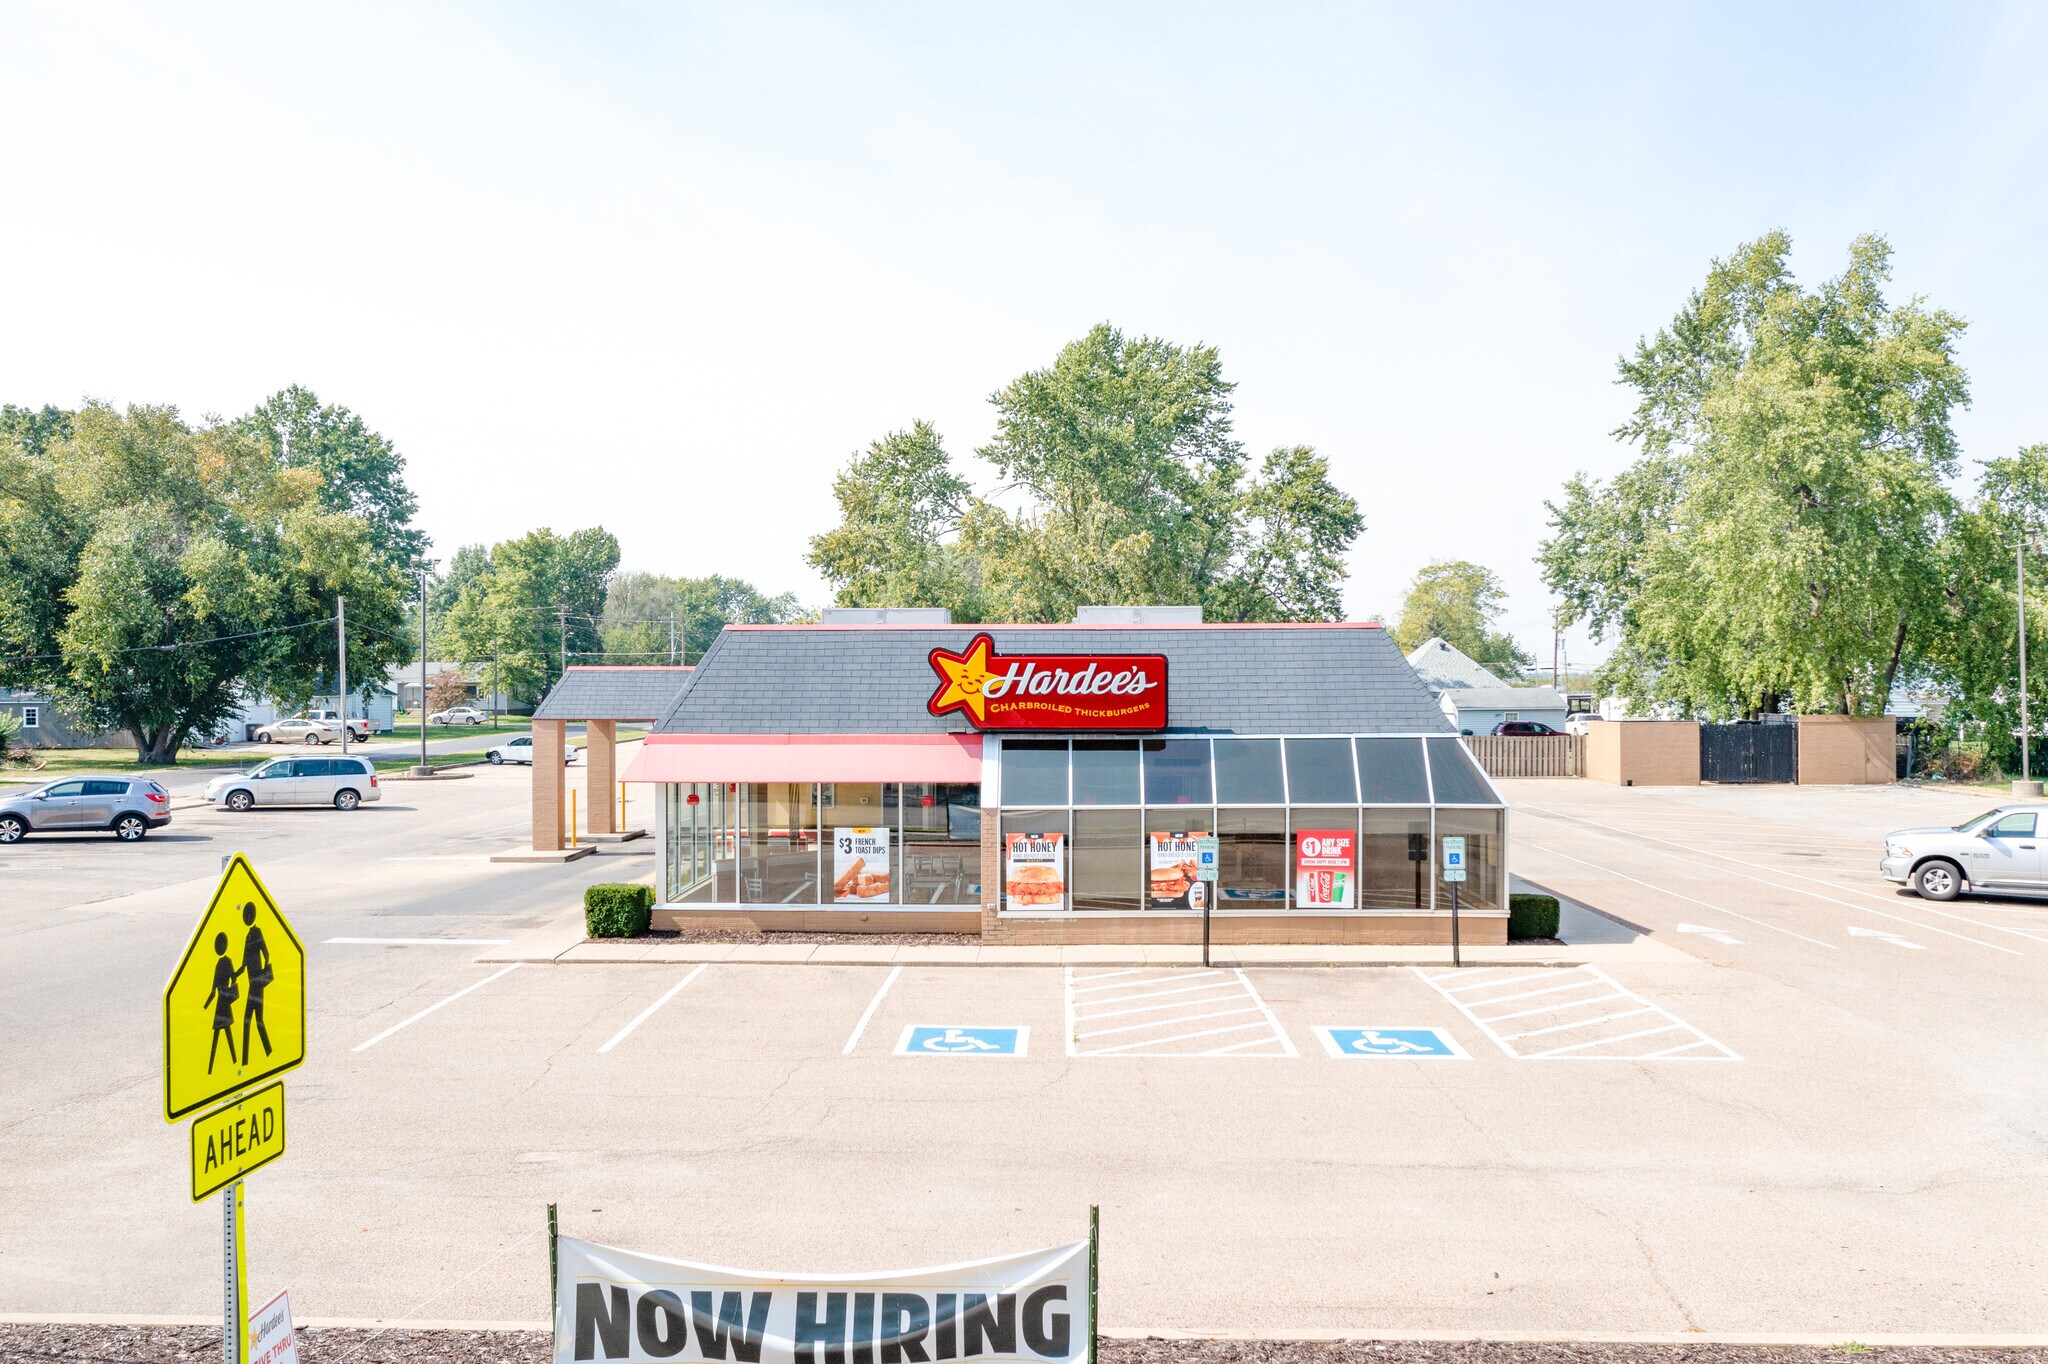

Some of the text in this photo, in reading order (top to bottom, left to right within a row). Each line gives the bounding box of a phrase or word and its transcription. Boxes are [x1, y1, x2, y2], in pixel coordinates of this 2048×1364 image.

[981, 662, 1158, 699] Hardee's
[990, 701, 1150, 718] CHARBROILED THICKBURGERS
[838, 837, 853, 855] $3
[854, 837, 876, 846] FRENCH
[1012, 841, 1057, 853] HOT HONEY
[1157, 841, 1198, 852] HOT HONE
[1305, 840, 1316, 855] $1
[1321, 838, 1350, 848] ANY SIZE
[854, 846, 886, 855] TOAST DIPS
[1321, 846, 1342, 855] DRINK
[204, 1106, 275, 1175] AHEAD
[574, 1282, 1071, 1364] NOW HIRING
[272, 1333, 292, 1359] THRU
